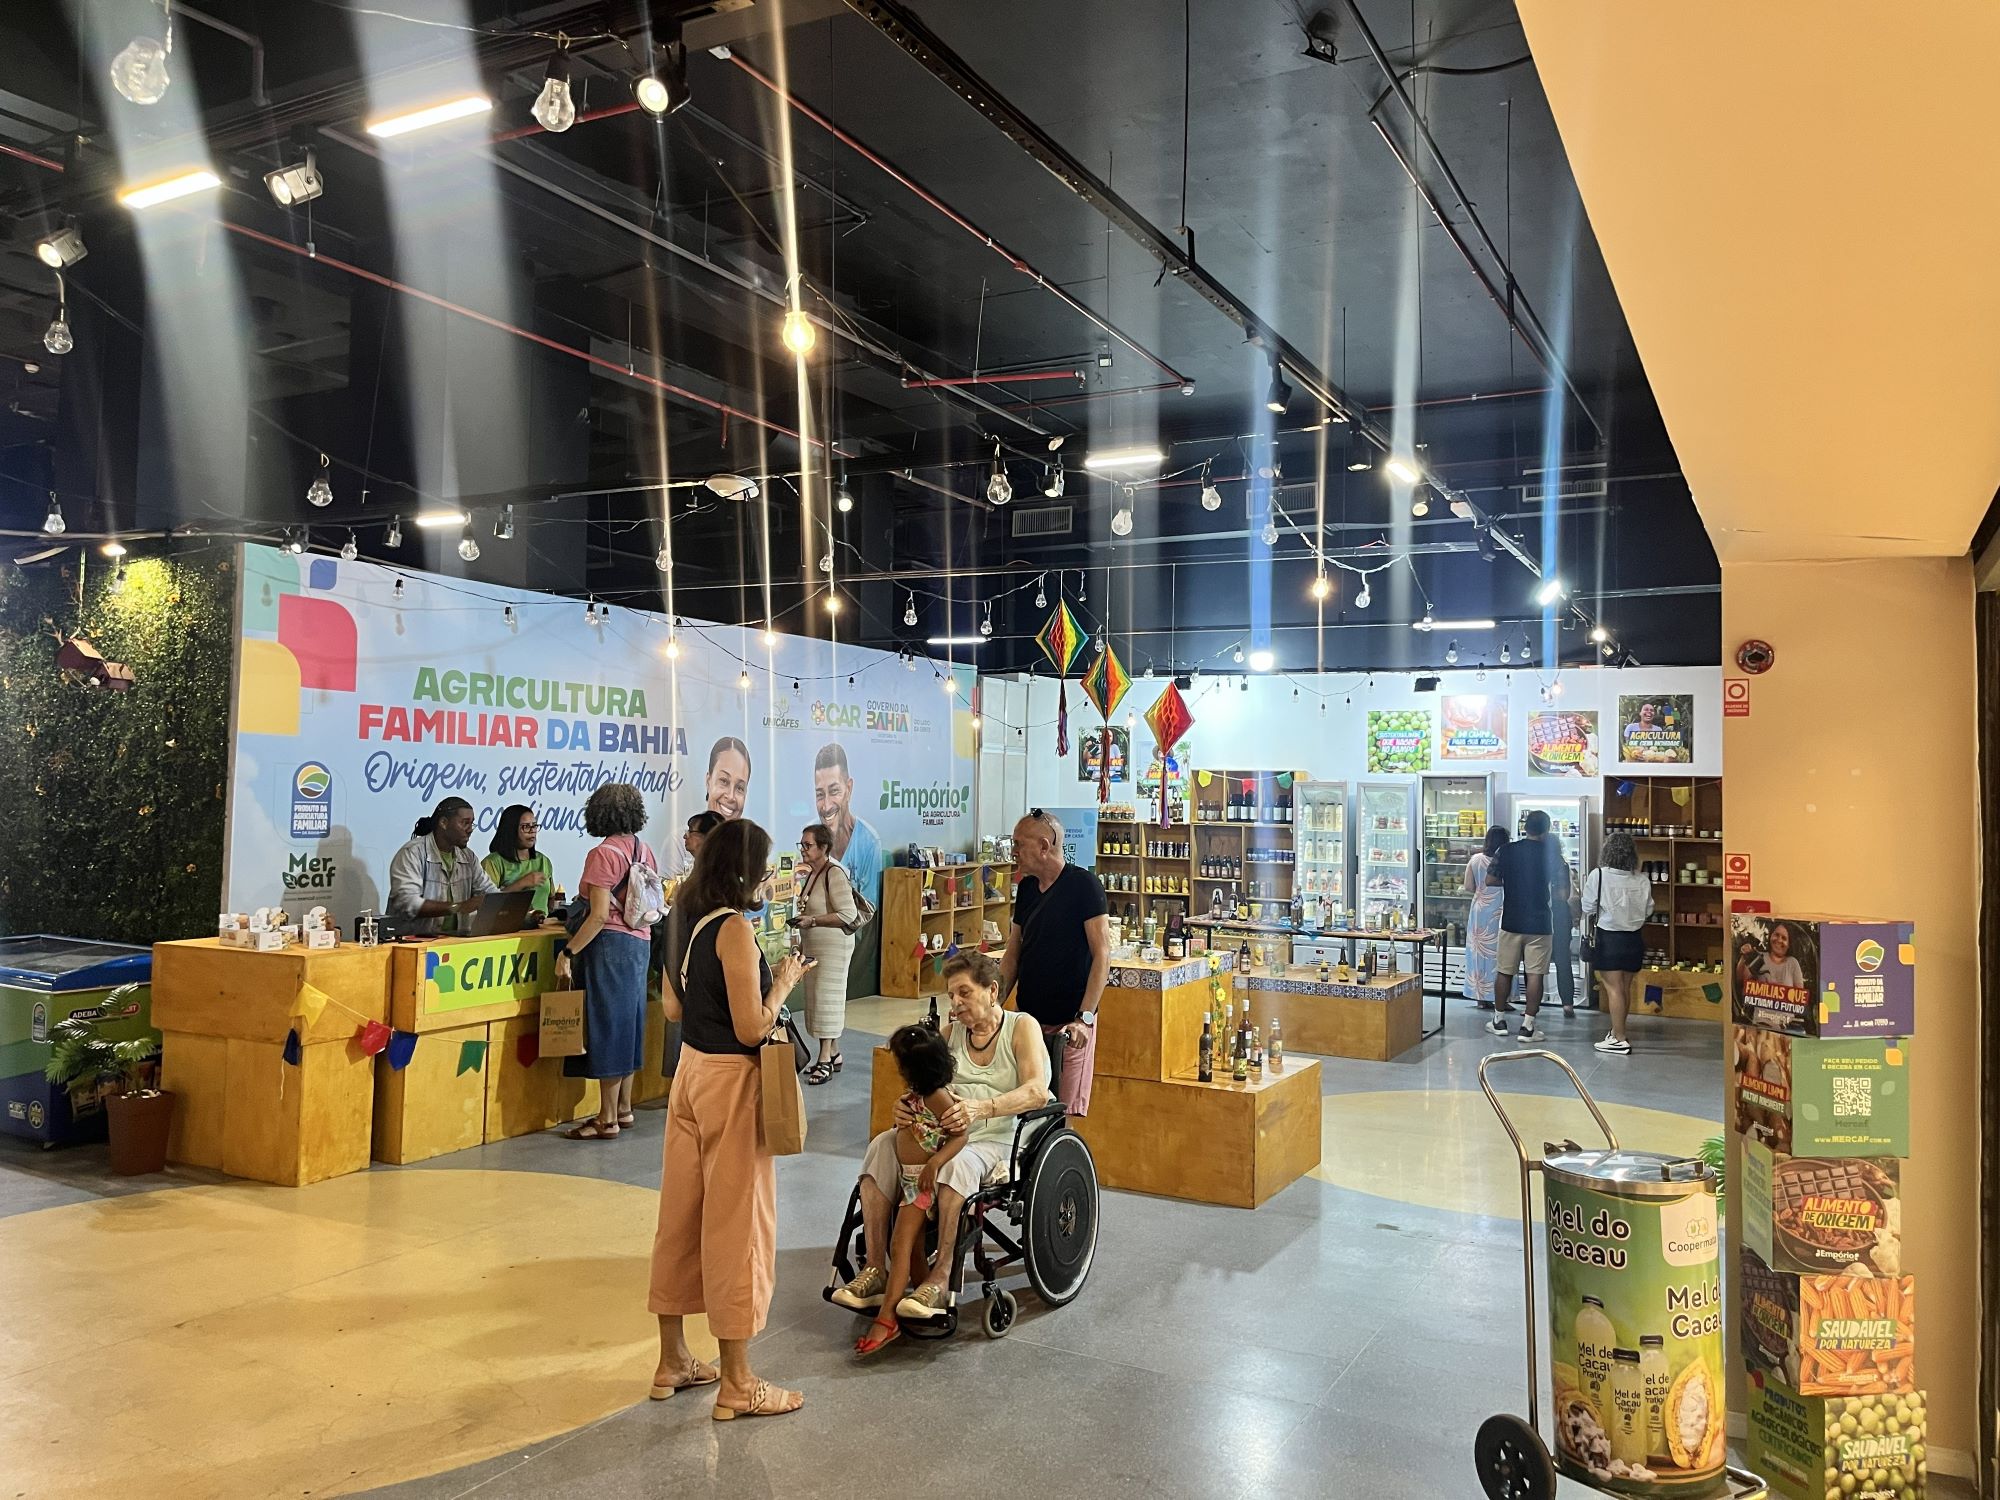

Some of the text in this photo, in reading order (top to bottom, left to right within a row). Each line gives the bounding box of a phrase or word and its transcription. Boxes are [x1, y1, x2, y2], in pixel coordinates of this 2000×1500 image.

[413, 667, 647, 718] AGRICULTURA
[867, 700, 909, 713] GOVERNO DA
[826, 703, 861, 729] CAR
[866, 710, 909, 732] BAHIA
[358, 703, 689, 756] FAMILIAR DA BAHIA
[1630, 731, 1681, 740] AGRICULTURA
[1543, 743, 1582, 752] ALIMENTO
[364, 750, 488, 802] Origem,
[890, 780, 961, 815] Empório
[294, 804, 328, 812] PRODUTO DA
[922, 810, 961, 819] DA AGRICULTURA
[293, 812, 328, 820] AGRICULTURA
[922, 818, 944, 826] FAMILIAR
[293, 820, 328, 831] FAMILIAR
[289, 852, 333, 873] Mer
[460, 951, 538, 991] CAIXA
[1787, 988, 1807, 1003] QUE
[1854, 993, 1884, 1003] FAMILIAR
[72, 1010, 97, 1019] ADEBA
[1774, 1001, 1779, 1009] O
[1780, 1002, 1805, 1014] FUTURO
[1804, 1197, 1872, 1214] ALIMENTO
[1548, 1196, 1630, 1240] Mel do
[1804, 1213, 1871, 1229] DE ORIGEM
[1550, 1229, 1627, 1269] Cacau
[1820, 1250, 1855, 1260] Empório
[1667, 1282, 1708, 1311] Mel
[1578, 1342, 1613, 1360] Mel de
[1819, 1339, 1891, 1350] POR NATUREZA
[1643, 1373, 1670, 1384] el de
[1614, 1389, 1641, 1399] Mel de
[1645, 1387, 1670, 1395] acau
[1614, 1398, 1641, 1407] Cacau
[1764, 1387, 1808, 1419] PRODUTOS
[1860, 1455, 1906, 1470] NATUREZA
